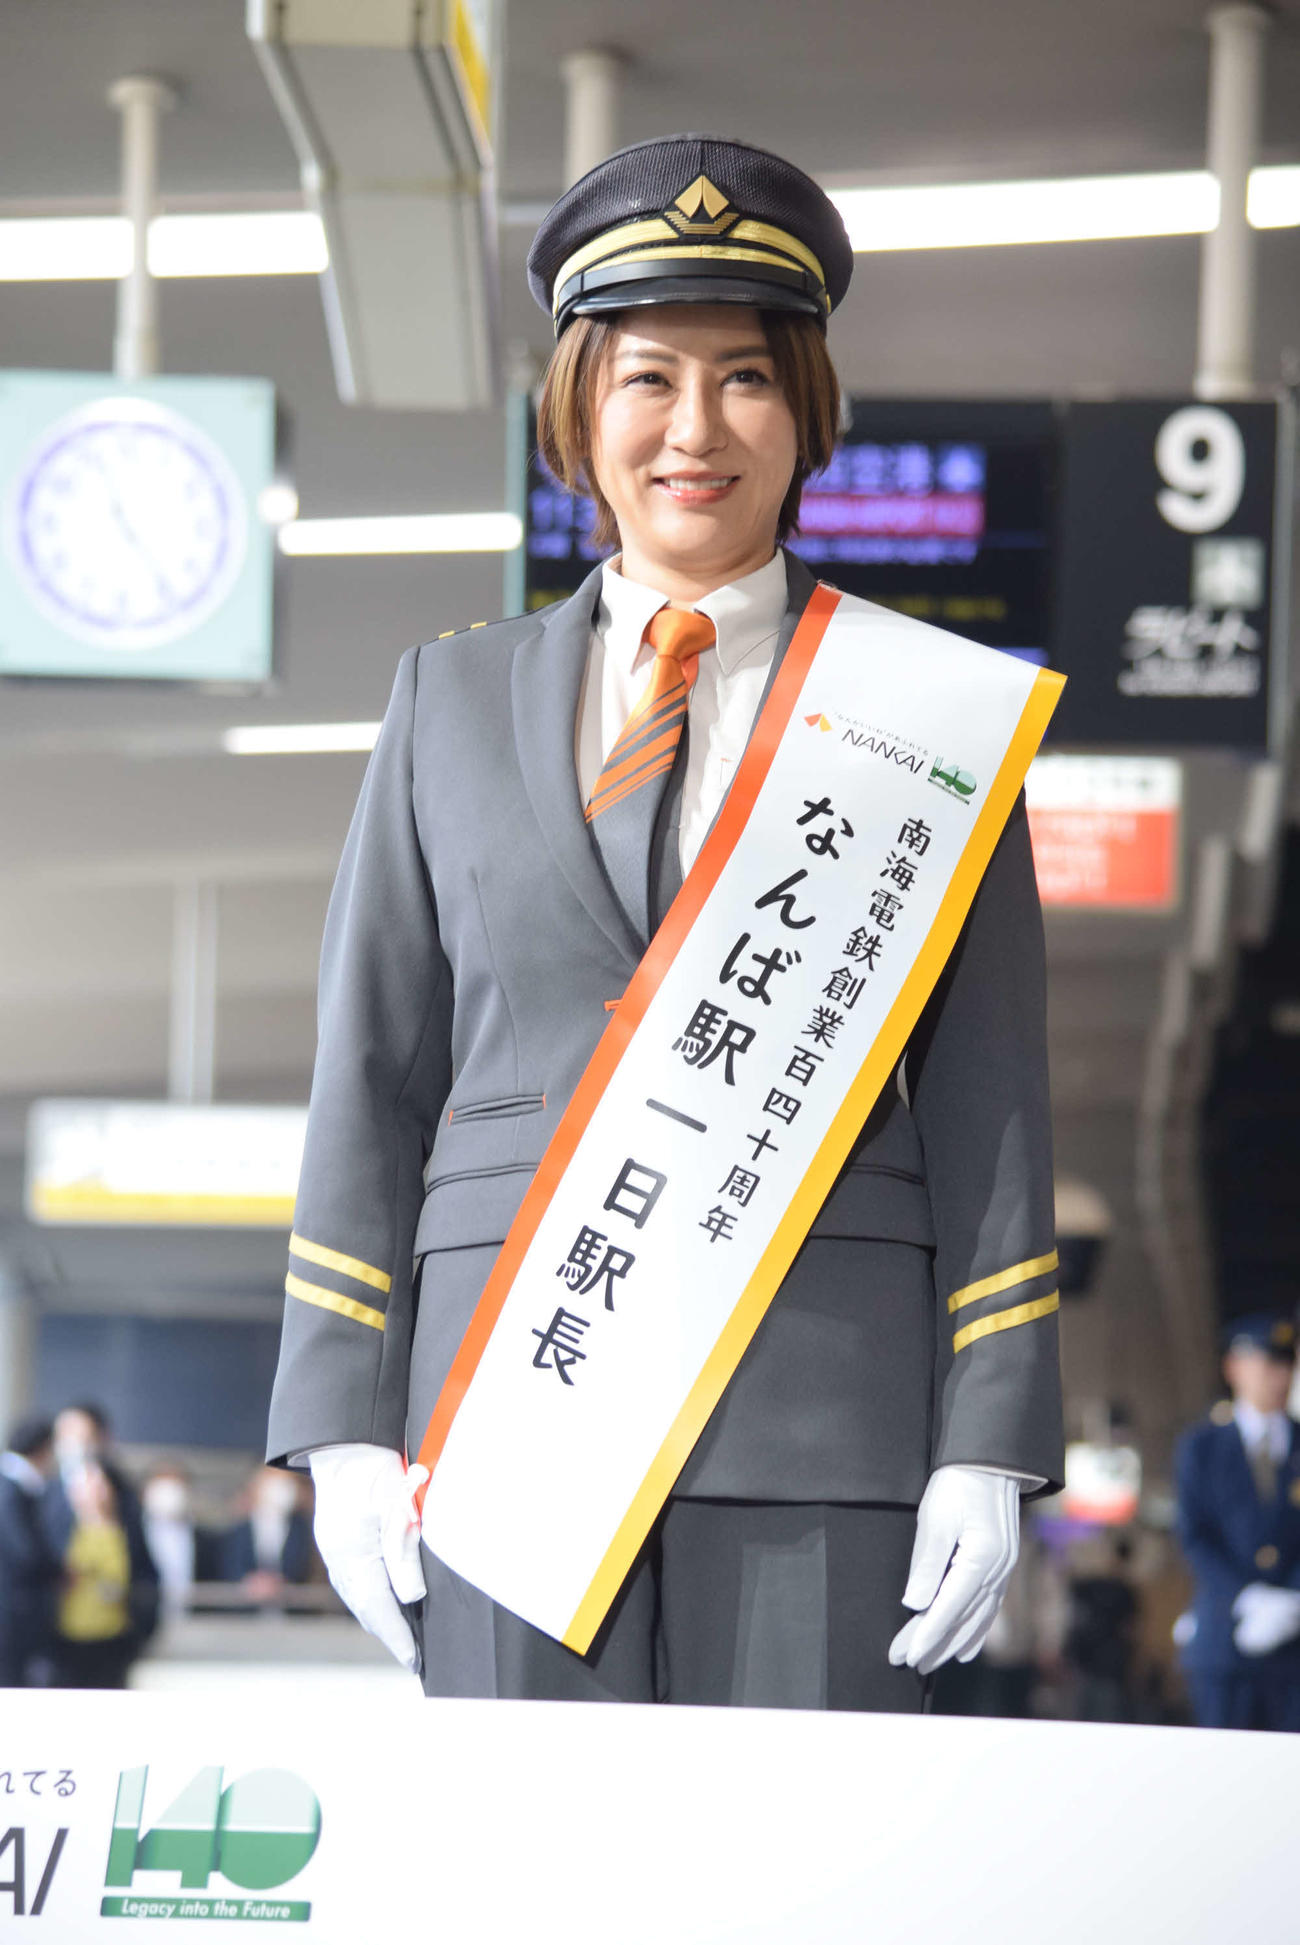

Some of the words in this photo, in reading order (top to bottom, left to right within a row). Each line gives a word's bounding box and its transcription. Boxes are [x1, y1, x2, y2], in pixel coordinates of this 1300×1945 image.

[1155, 404, 1245, 533] 9
[842, 729, 925, 774] NANKAI
[531, 797, 855, 1386] なんば駅一日駅長
[698, 817, 932, 1243] 南海電鉄創業百四十周年
[121, 1899, 175, 1918] Legacy
[179, 1900, 209, 1917] into
[213, 1901, 238, 1918] the
[242, 1901, 291, 1919] Future
